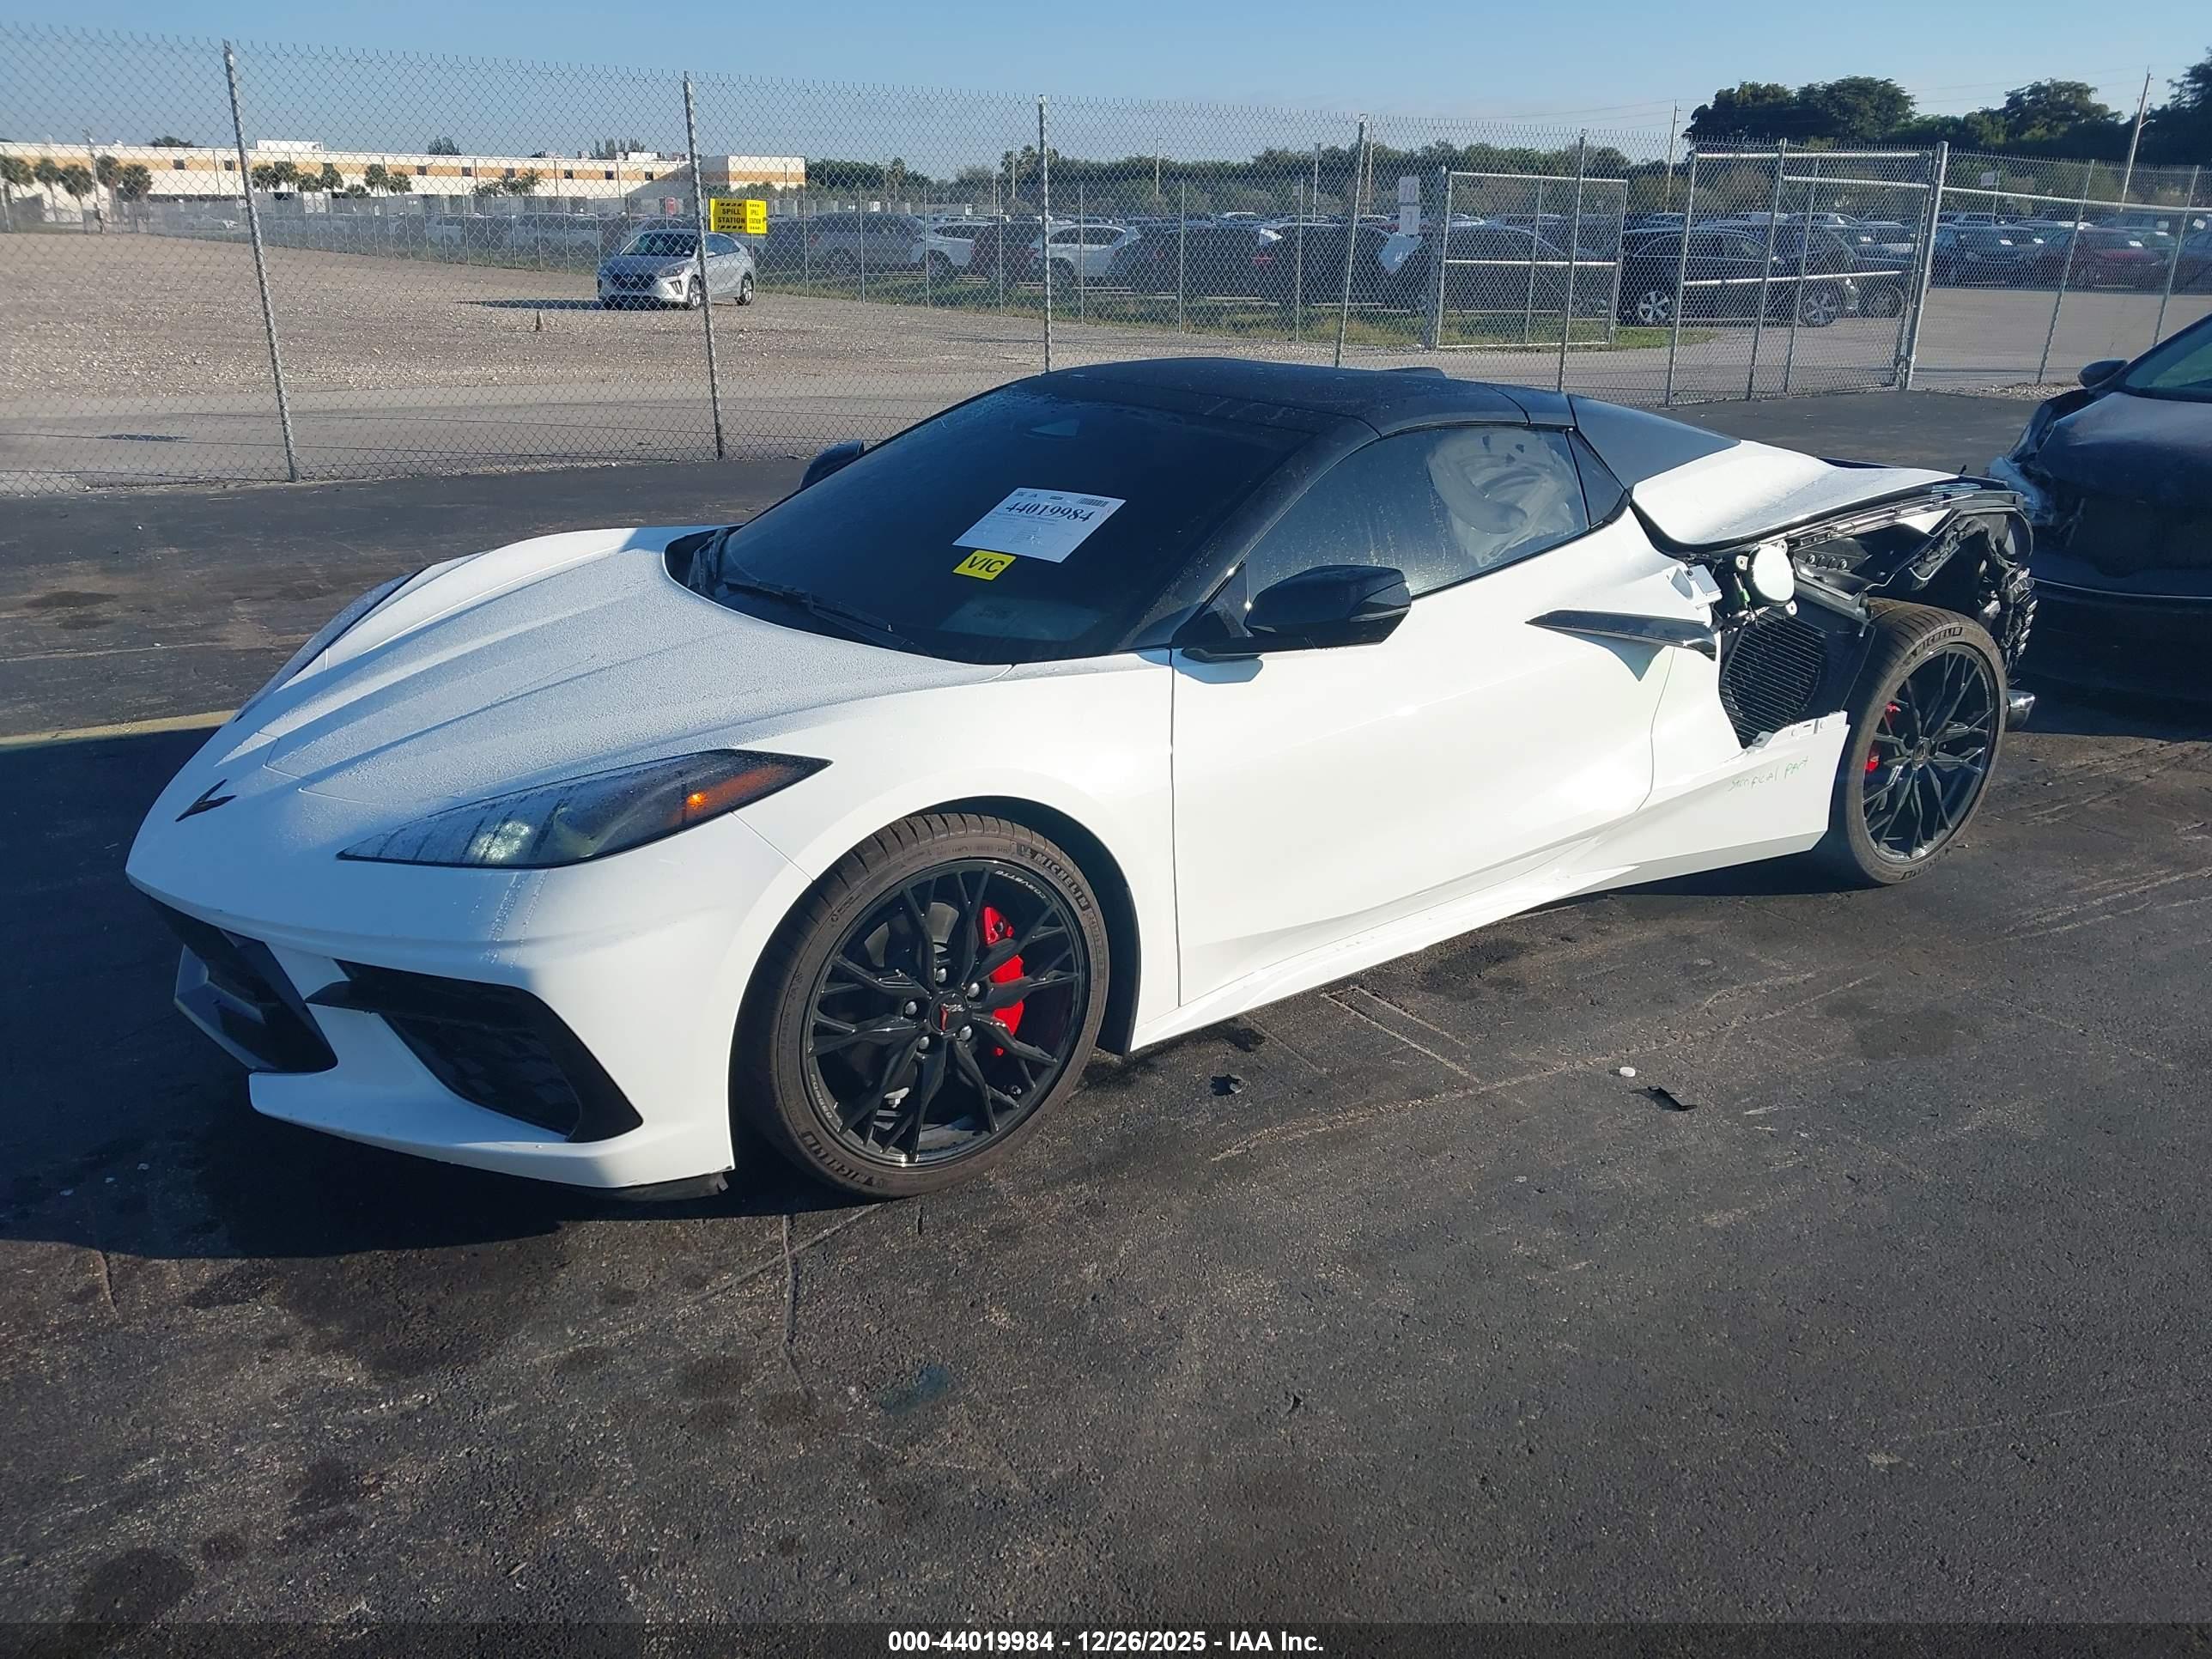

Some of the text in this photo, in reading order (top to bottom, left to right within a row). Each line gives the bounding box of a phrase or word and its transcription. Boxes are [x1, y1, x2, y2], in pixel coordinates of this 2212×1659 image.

[1006, 501, 1096, 523] 44019984
[967, 556, 1006, 574] VIC
[1916, 627, 1961, 654] MICHELIN
[994, 869, 1048, 900] CORVETTE
[1034, 850, 1088, 911] MICHELIN
